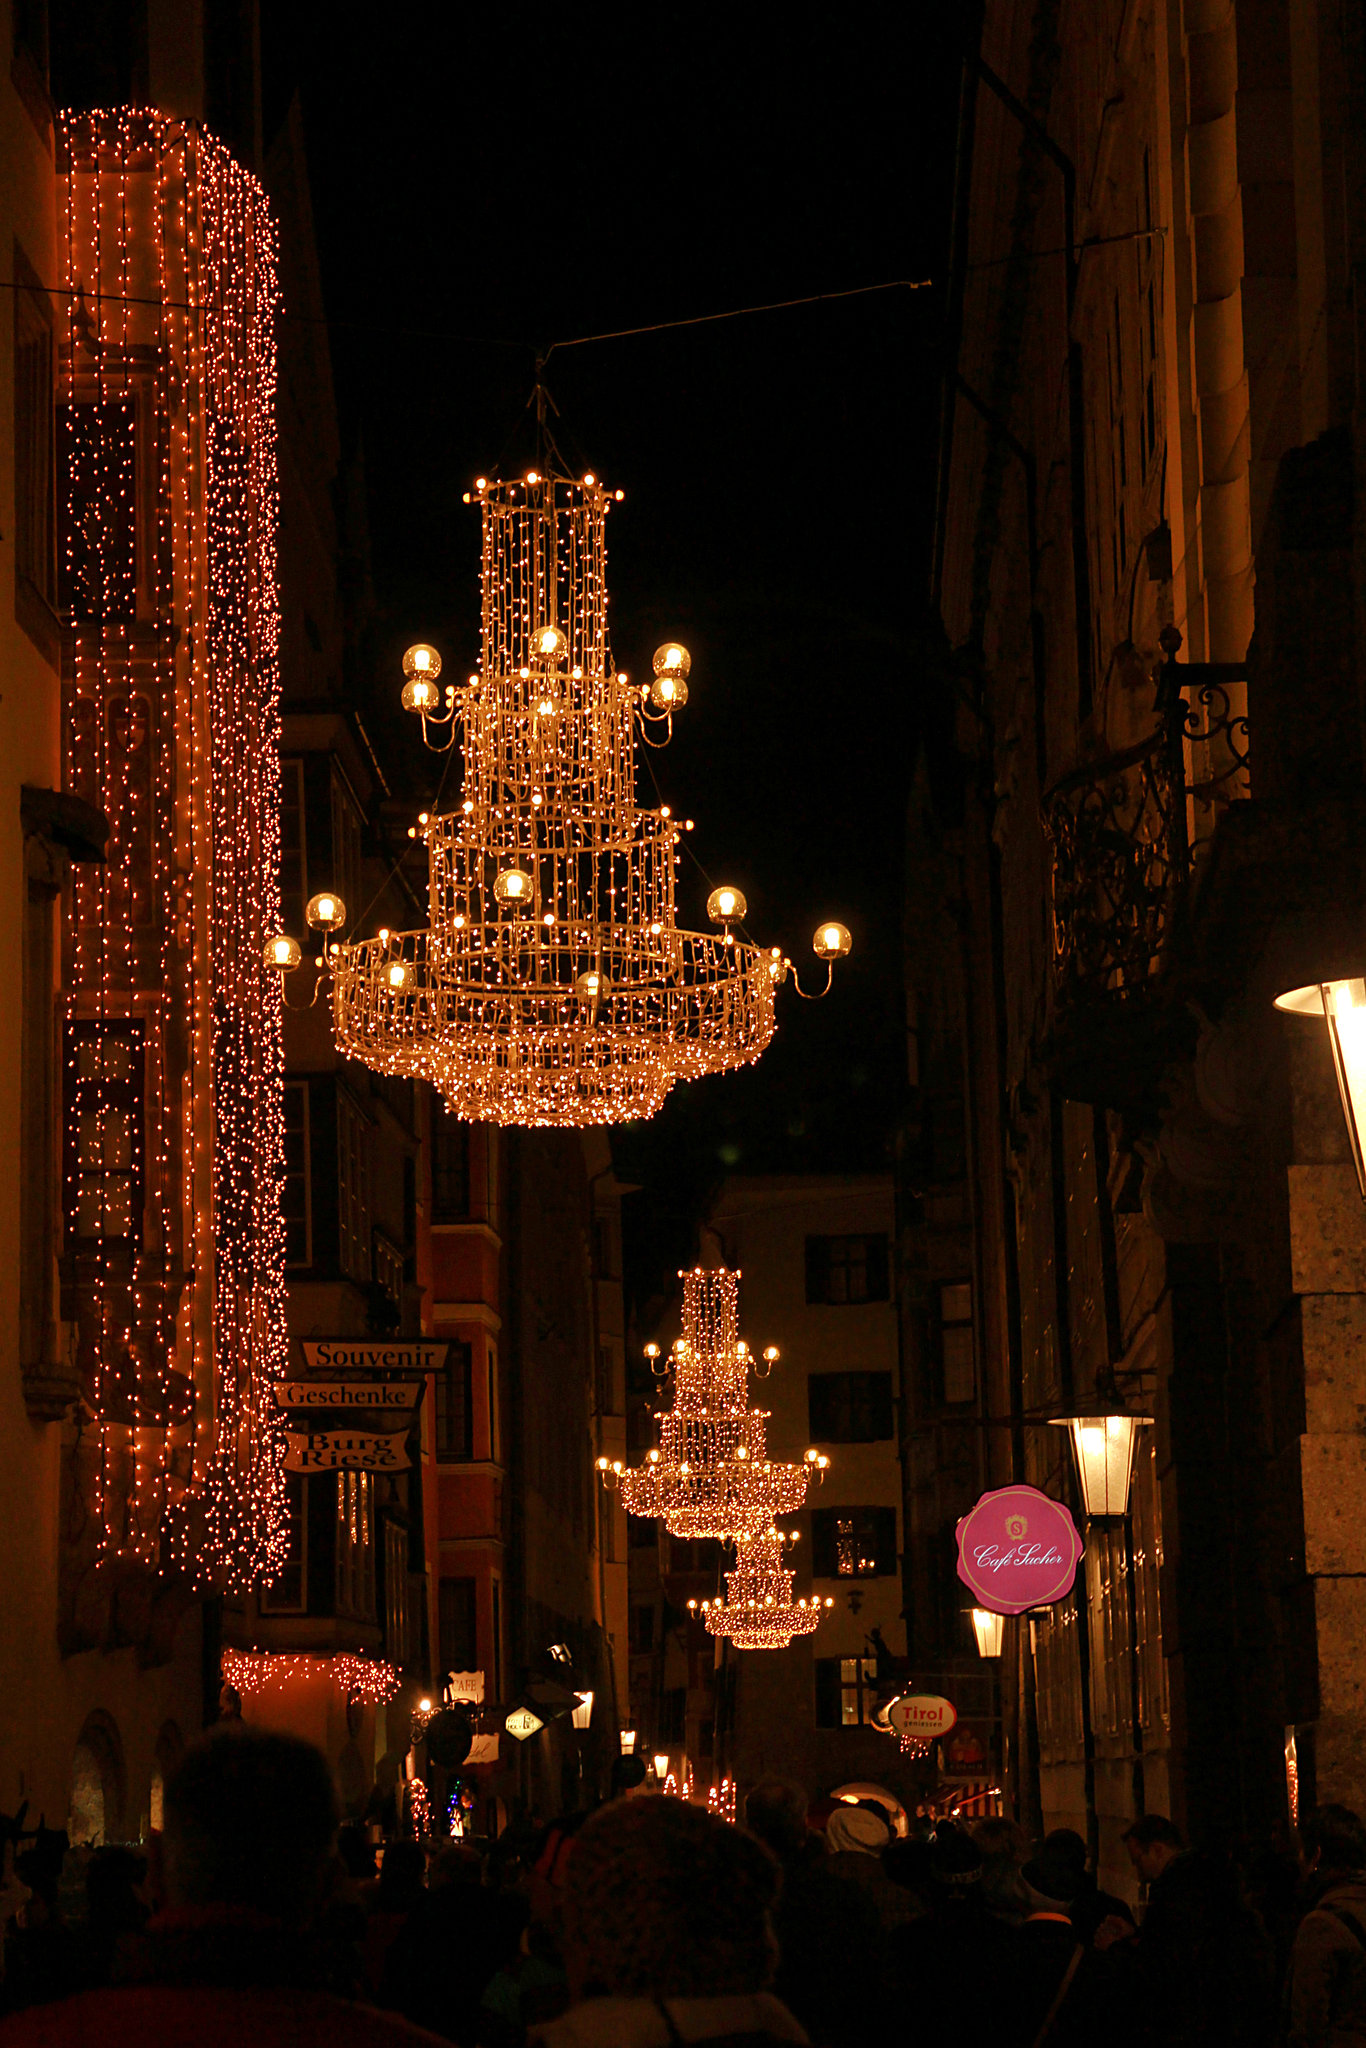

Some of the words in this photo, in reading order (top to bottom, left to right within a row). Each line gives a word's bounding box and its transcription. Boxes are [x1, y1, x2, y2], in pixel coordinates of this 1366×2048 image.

[317, 1344, 434, 1366] Souvenir
[287, 1385, 406, 1404] Geschenke
[307, 1435, 392, 1455] Burg
[301, 1451, 397, 1466] Riese
[973, 1544, 1016, 1573] Café
[1014, 1543, 1064, 1567] Sacher
[903, 1706, 943, 1721] Tirol
[904, 1720, 943, 1728] geniessen
